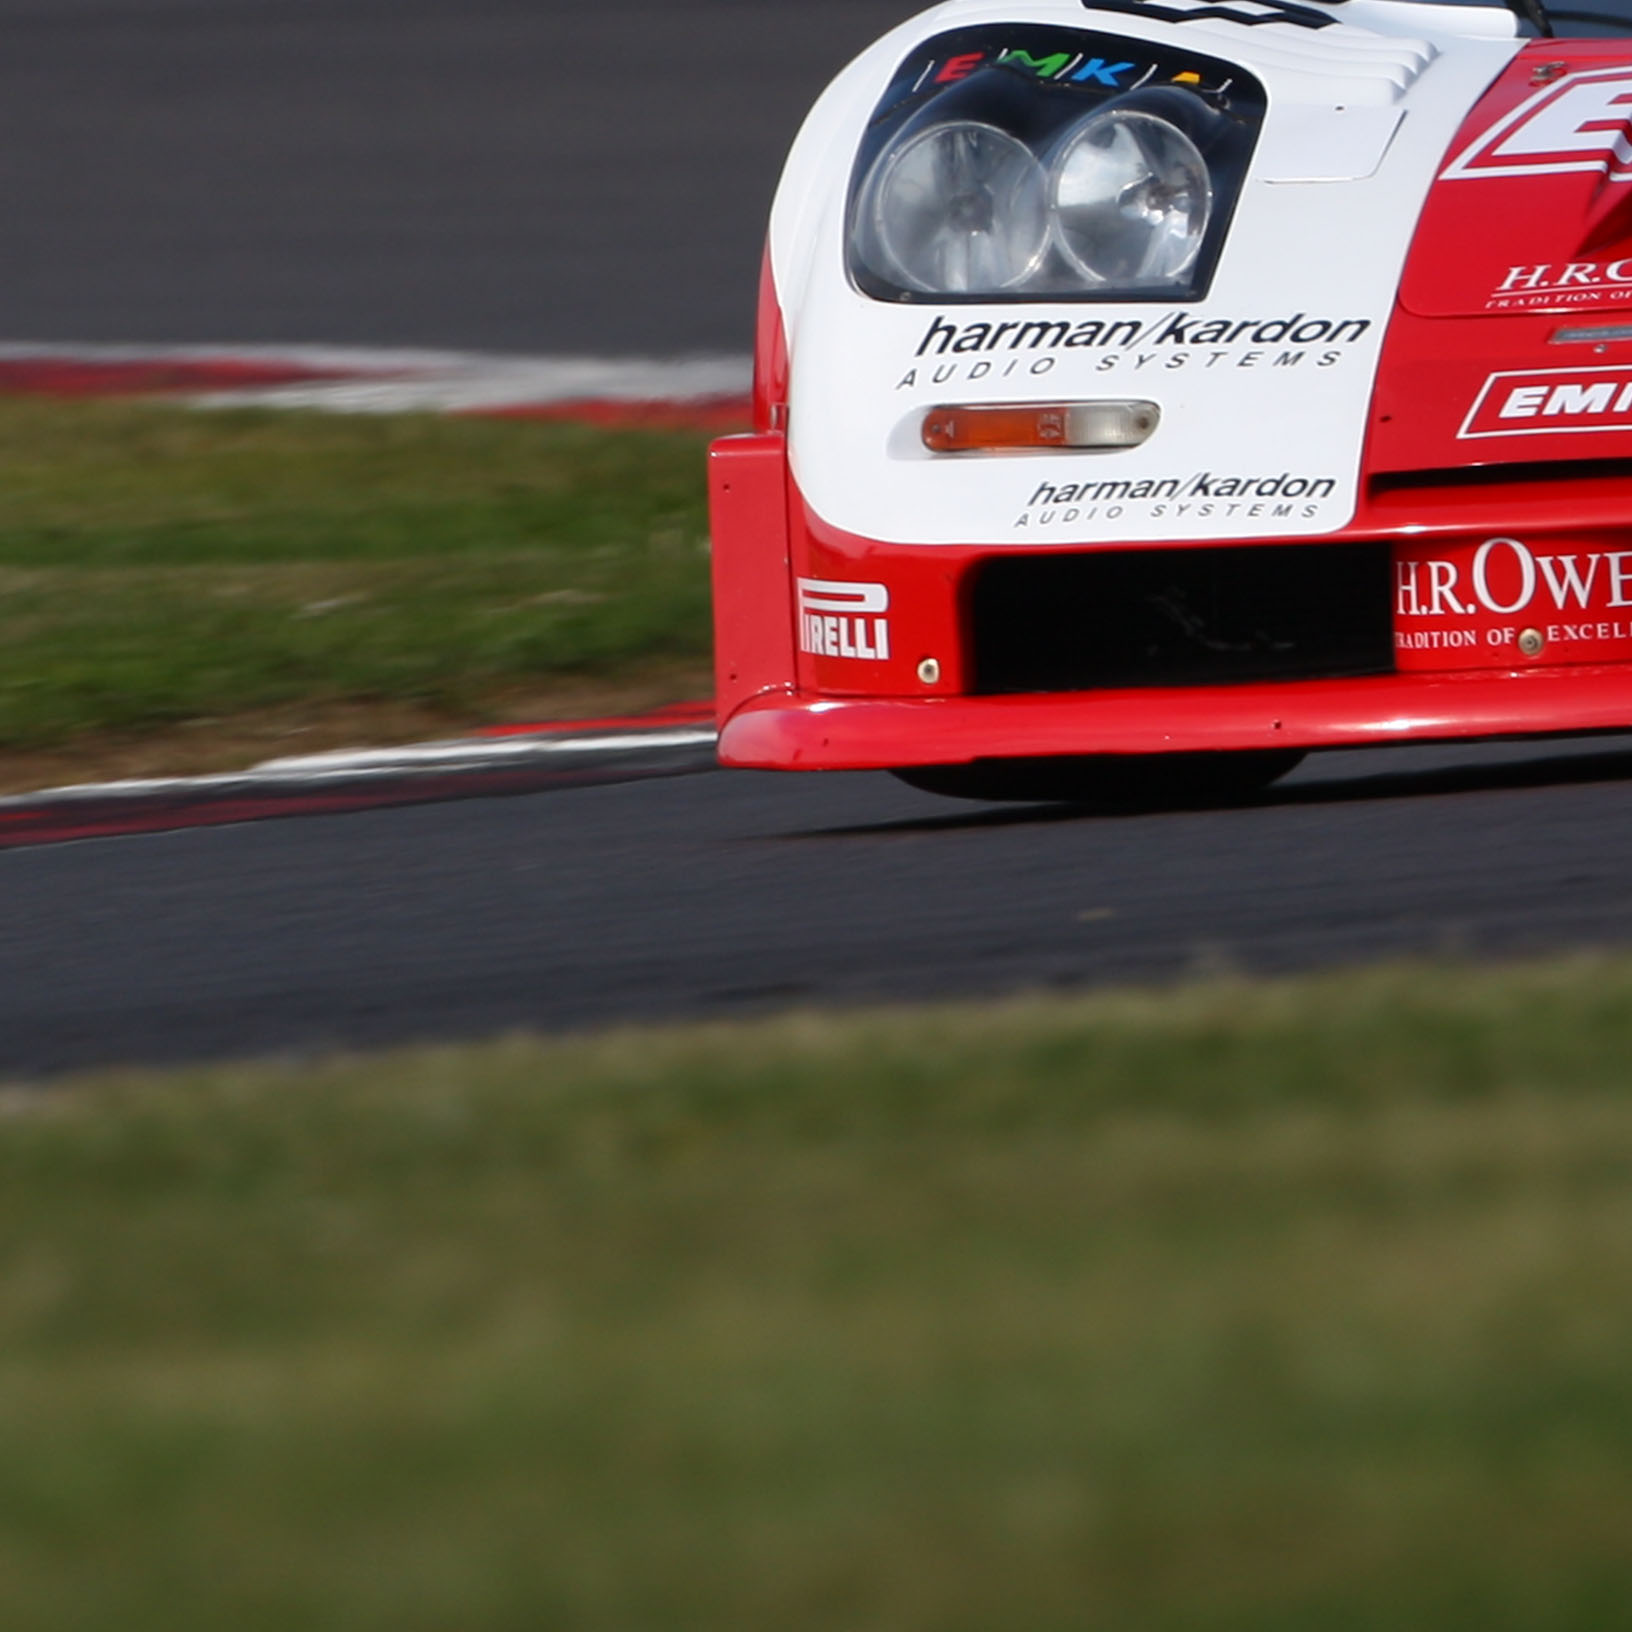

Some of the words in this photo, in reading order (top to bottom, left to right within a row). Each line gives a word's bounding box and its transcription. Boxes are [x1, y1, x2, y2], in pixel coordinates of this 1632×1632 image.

[1484, 290, 1600, 309] TRADITION
[915, 313, 1370, 356] harman/kardon
[896, 357, 1056, 389] AUDIO
[1096, 350, 1343, 372] SYSTEMS
[1028, 473, 1338, 507] harman/kardon
[1013, 505, 1125, 528] AUDIO
[1149, 502, 1321, 519] SYSTEMS
[797, 577, 889, 660] PIRELLI
[1395, 629, 1476, 649] RADITION
[1486, 626, 1516, 647] OF
